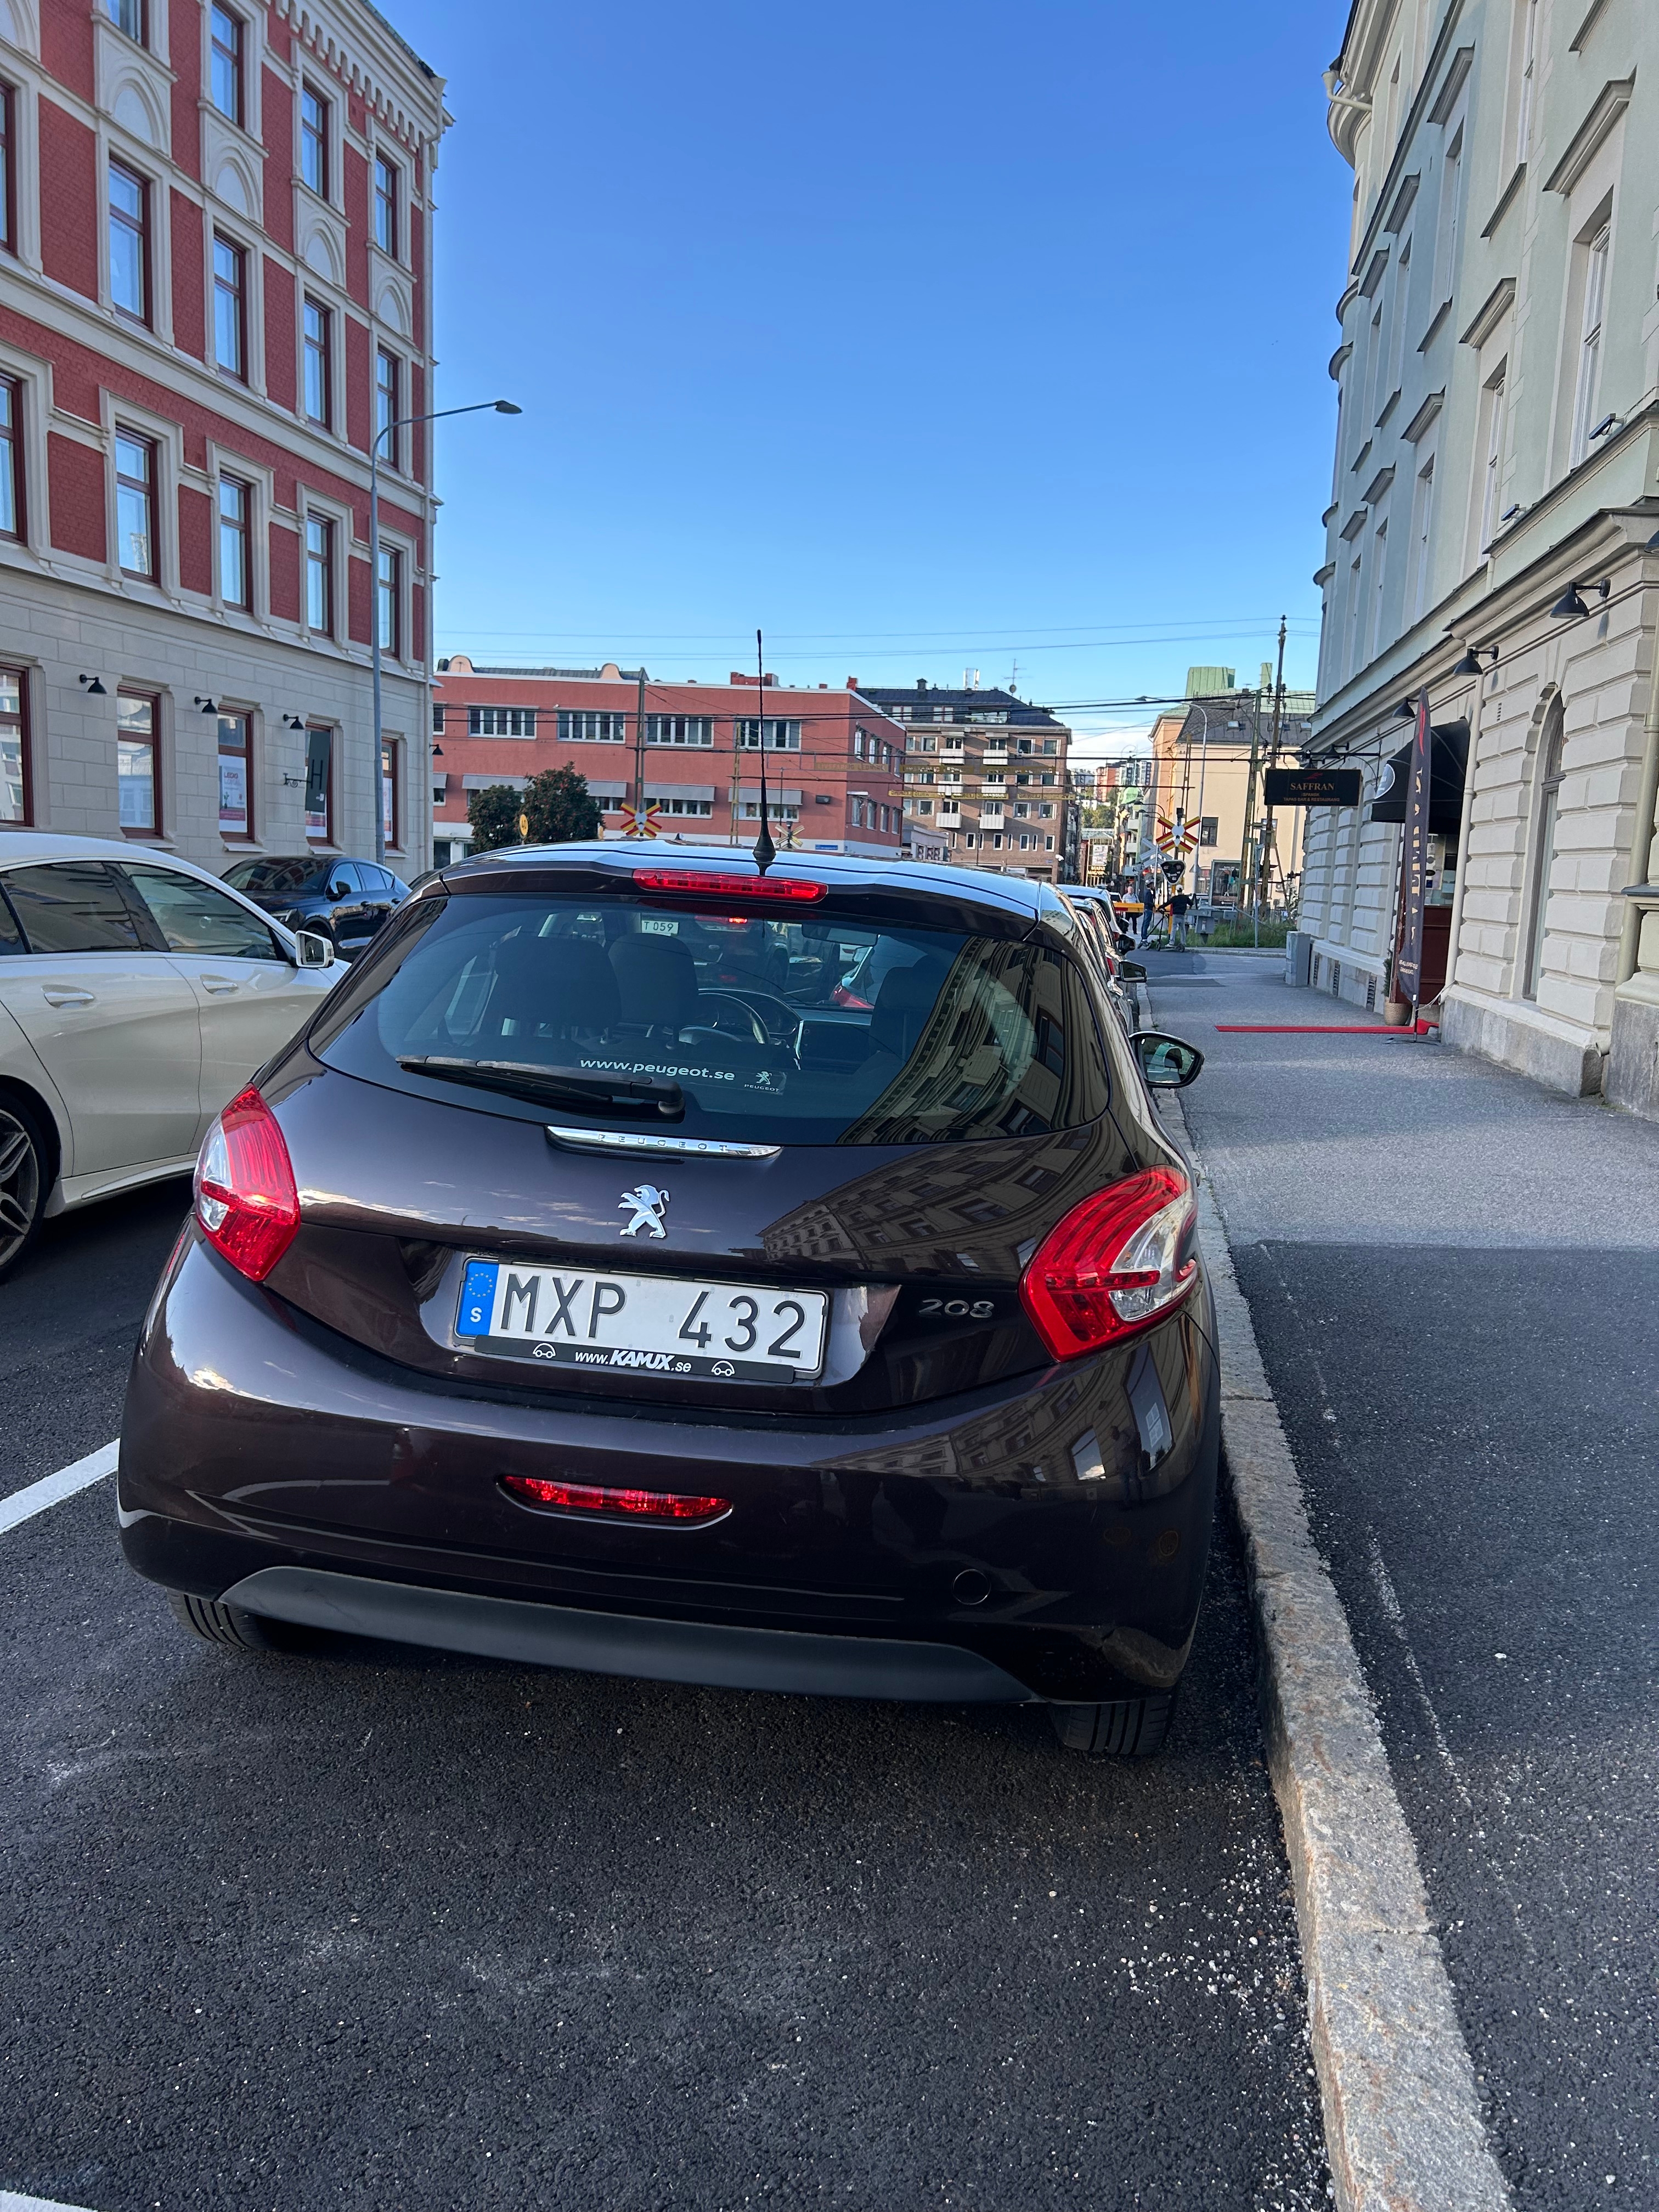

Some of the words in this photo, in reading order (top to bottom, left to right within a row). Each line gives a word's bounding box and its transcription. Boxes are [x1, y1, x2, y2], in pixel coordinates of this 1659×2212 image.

[1290, 782, 1334, 791] SAFFRAN
[644, 921, 650, 930] T
[653, 922, 674, 932] 059
[580, 1059, 735, 1081] www.peugeot.se
[744, 1084, 780, 1092] PEUGEOT
[598, 1133, 728, 1152] PEUGEOT
[470, 1306, 481, 1323] S
[500, 1273, 627, 1338] MXP
[678, 1290, 806, 1358] 432
[918, 1299, 995, 1318] 208
[575, 1348, 692, 1373] www.KAMUX.se
